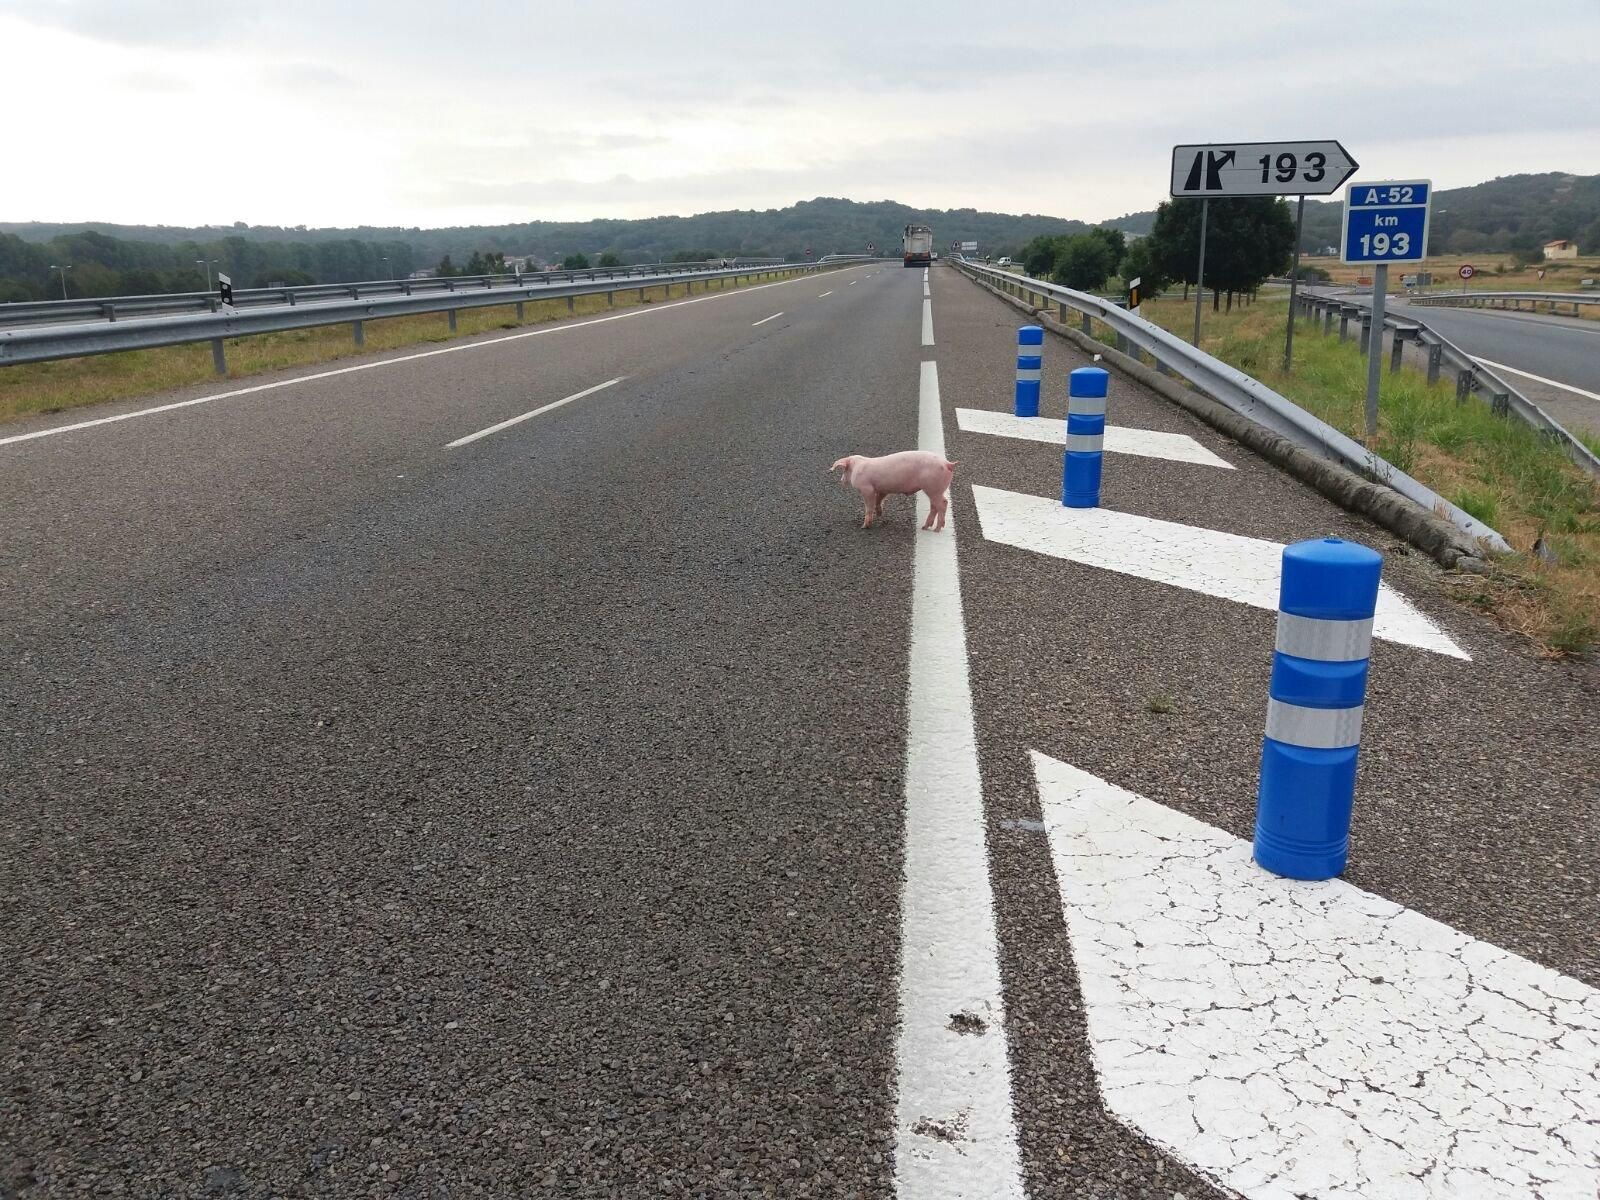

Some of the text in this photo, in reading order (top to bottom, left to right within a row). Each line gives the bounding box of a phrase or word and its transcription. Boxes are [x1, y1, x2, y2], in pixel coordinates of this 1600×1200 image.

[1259, 152, 1327, 184] 193
[1364, 186, 1414, 204] A-52
[1374, 214, 1399, 227] km
[1360, 233, 1410, 257] 193
